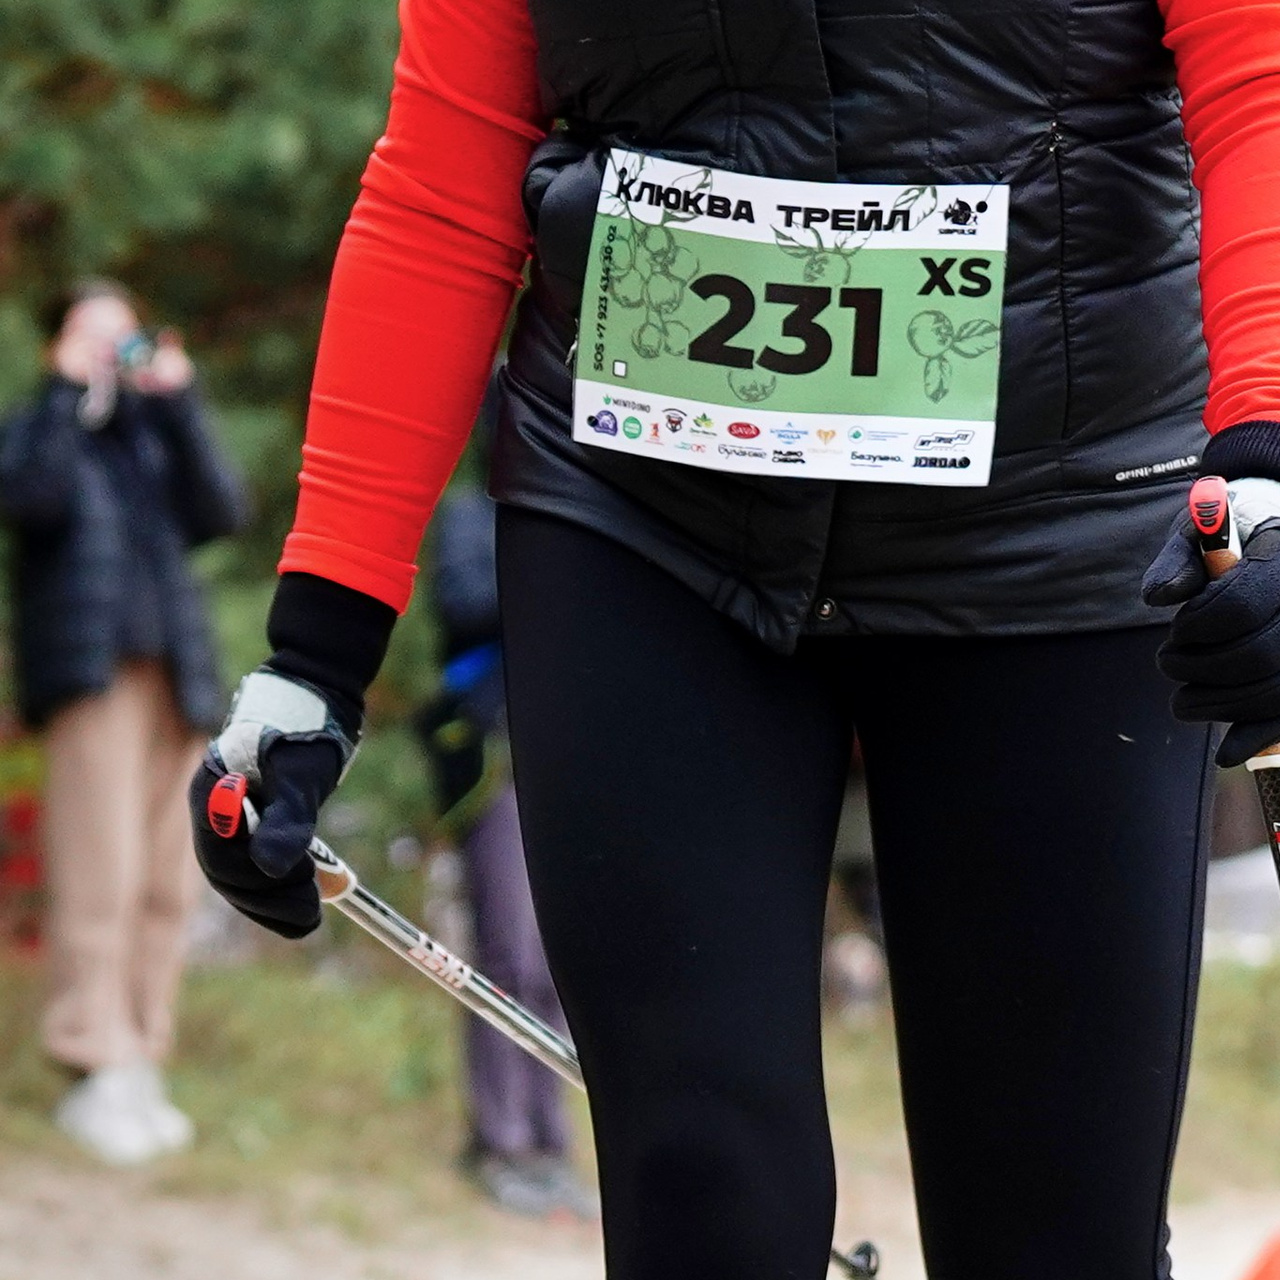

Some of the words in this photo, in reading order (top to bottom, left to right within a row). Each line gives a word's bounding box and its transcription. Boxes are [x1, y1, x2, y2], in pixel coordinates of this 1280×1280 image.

[616, 178, 755, 223] КЛЮКВА
[776, 201, 910, 231] ТРЕЙЛ
[607, 225, 617, 242] 02
[917, 257, 992, 297] XS
[597, 296, 608, 320] 923
[688, 273, 883, 377] 231
[593, 342, 605, 371] SOS
